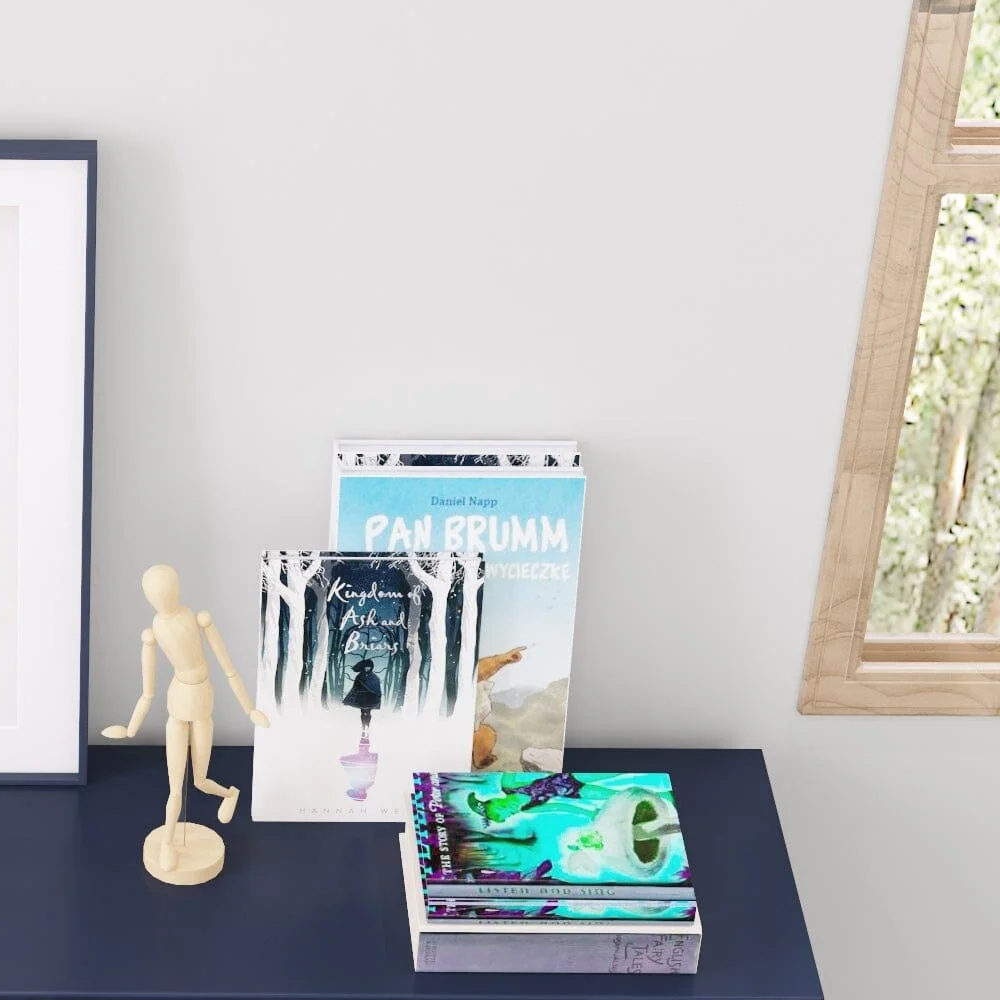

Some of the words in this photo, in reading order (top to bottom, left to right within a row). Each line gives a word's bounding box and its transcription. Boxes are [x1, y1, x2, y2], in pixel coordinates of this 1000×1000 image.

[430, 496, 466, 506] Daniel
[469, 496, 498, 508] Napp
[364, 514, 433, 552] PAN
[444, 514, 569, 553] BRUMM
[327, 576, 403, 606] Kingdom
[407, 583, 425, 605] of
[339, 606, 378, 630] Ash
[381, 611, 408, 629] and
[343, 630, 399, 656] Briars
[437, 827, 451, 852] STORY
[441, 855, 453, 875] THE
